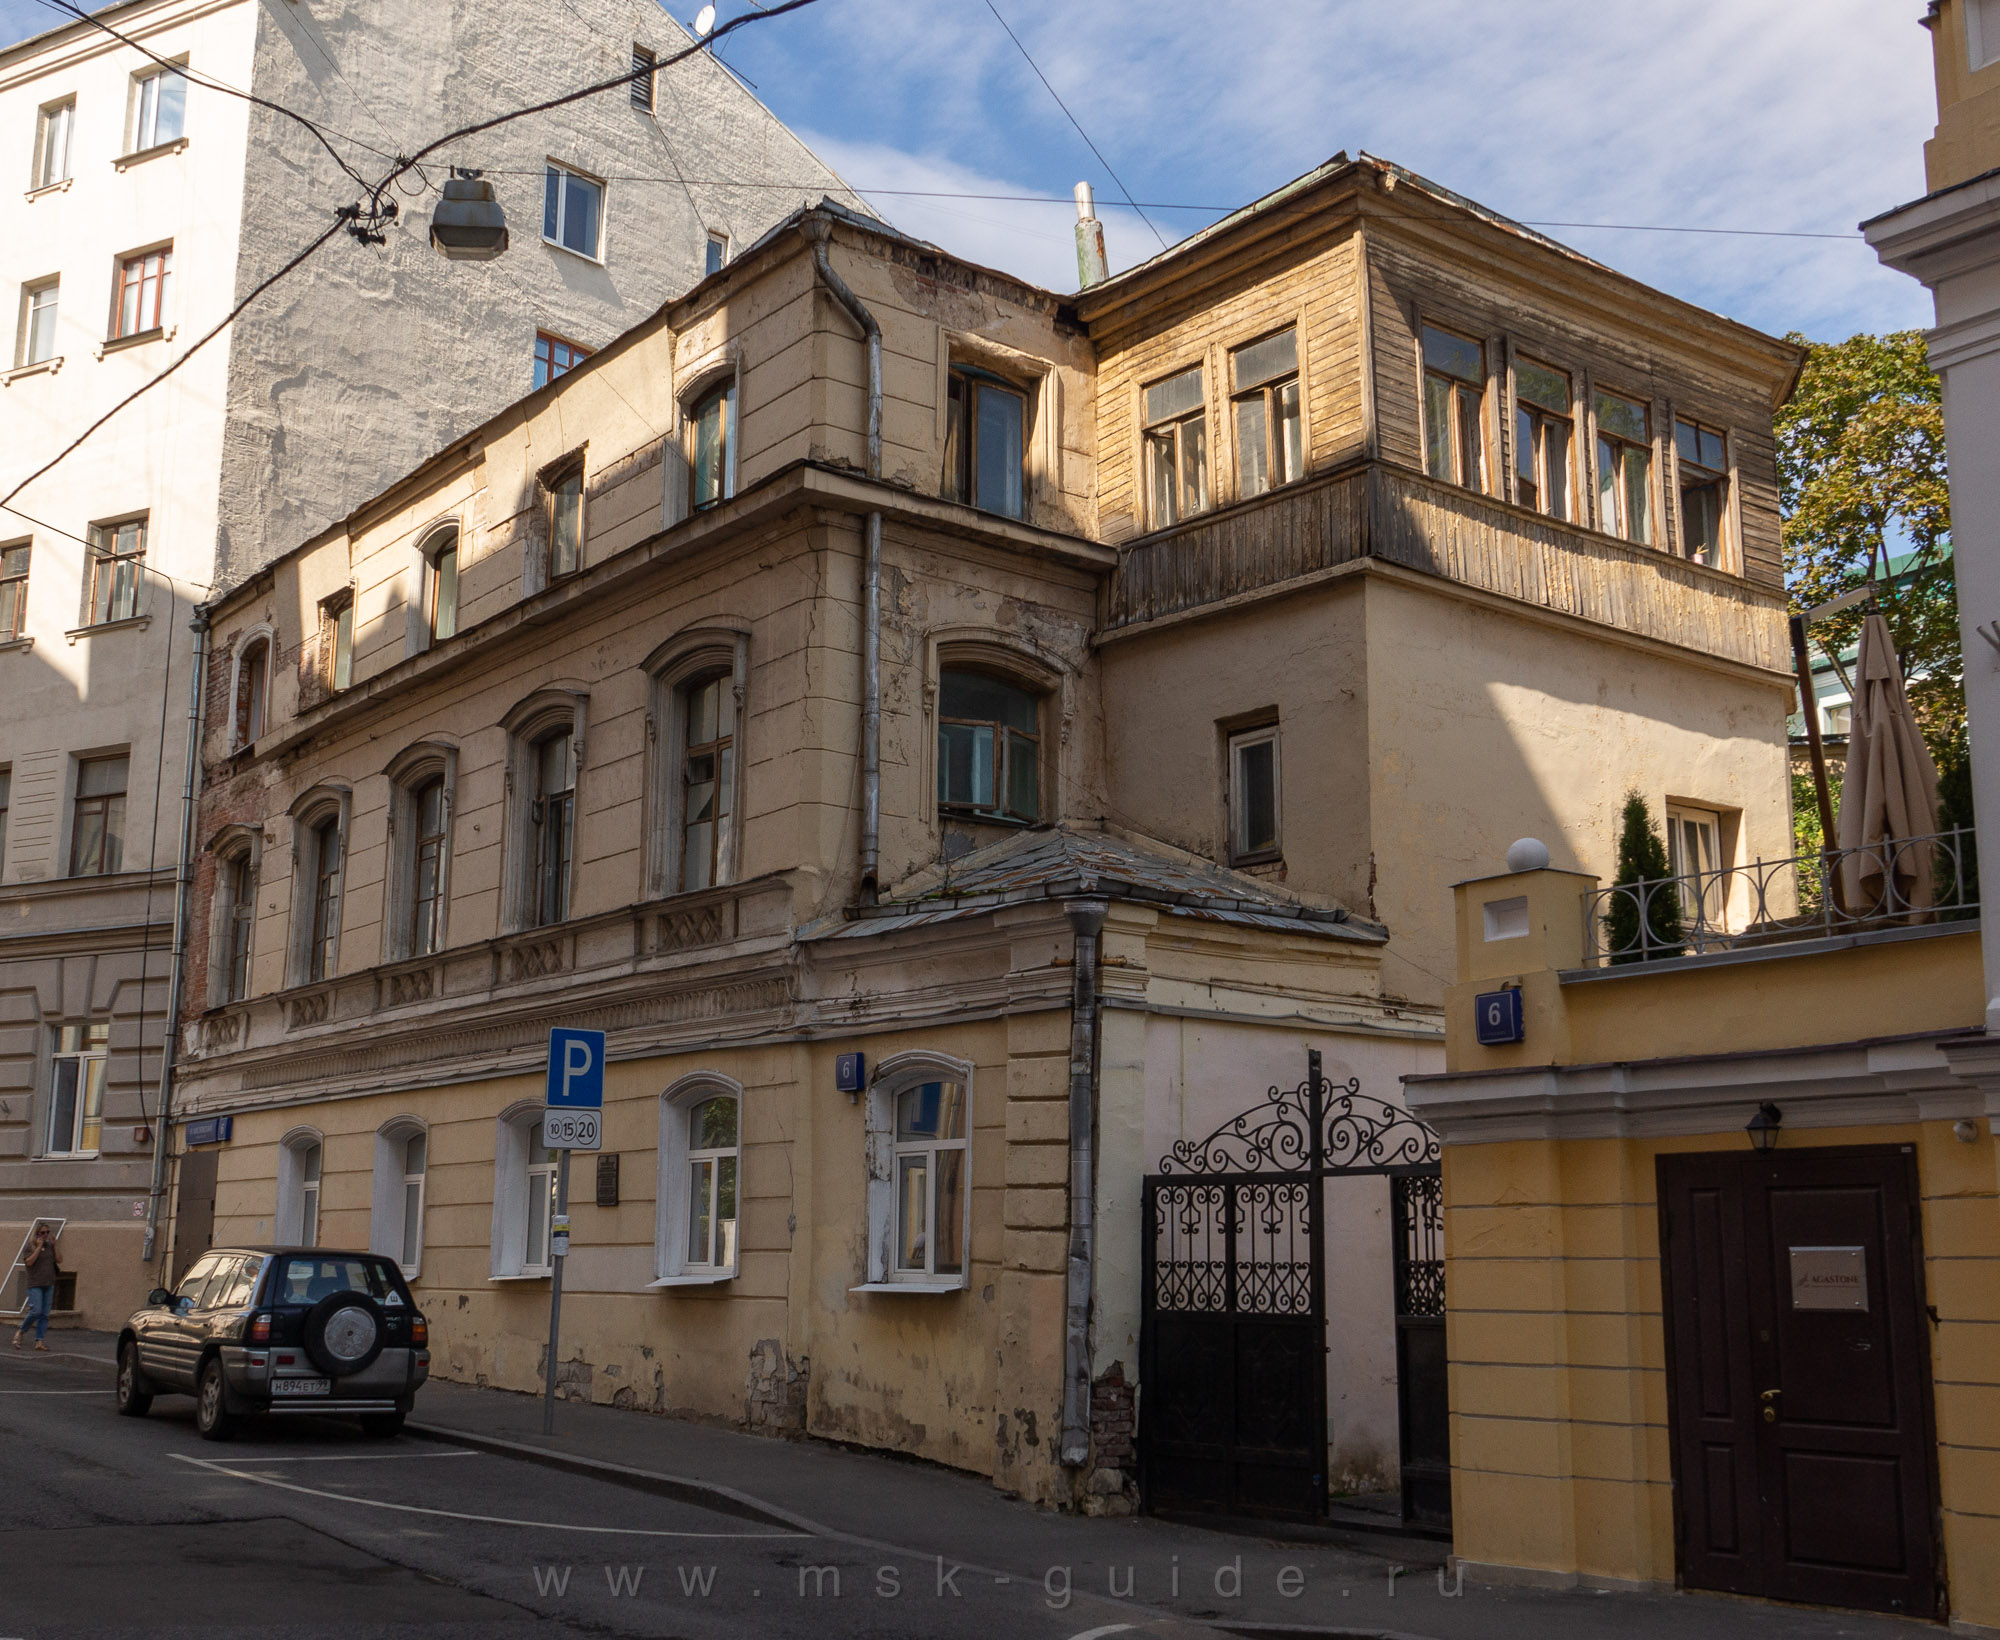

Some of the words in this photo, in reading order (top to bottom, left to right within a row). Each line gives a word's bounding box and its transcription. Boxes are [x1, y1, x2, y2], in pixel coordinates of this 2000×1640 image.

[1488, 1002, 1501, 1026] 6
[562, 1039, 593, 1097] P
[842, 1061, 850, 1079] 6
[550, 1123, 560, 1135] 10
[563, 1122, 574, 1137] 15
[577, 1121, 595, 1138] 20
